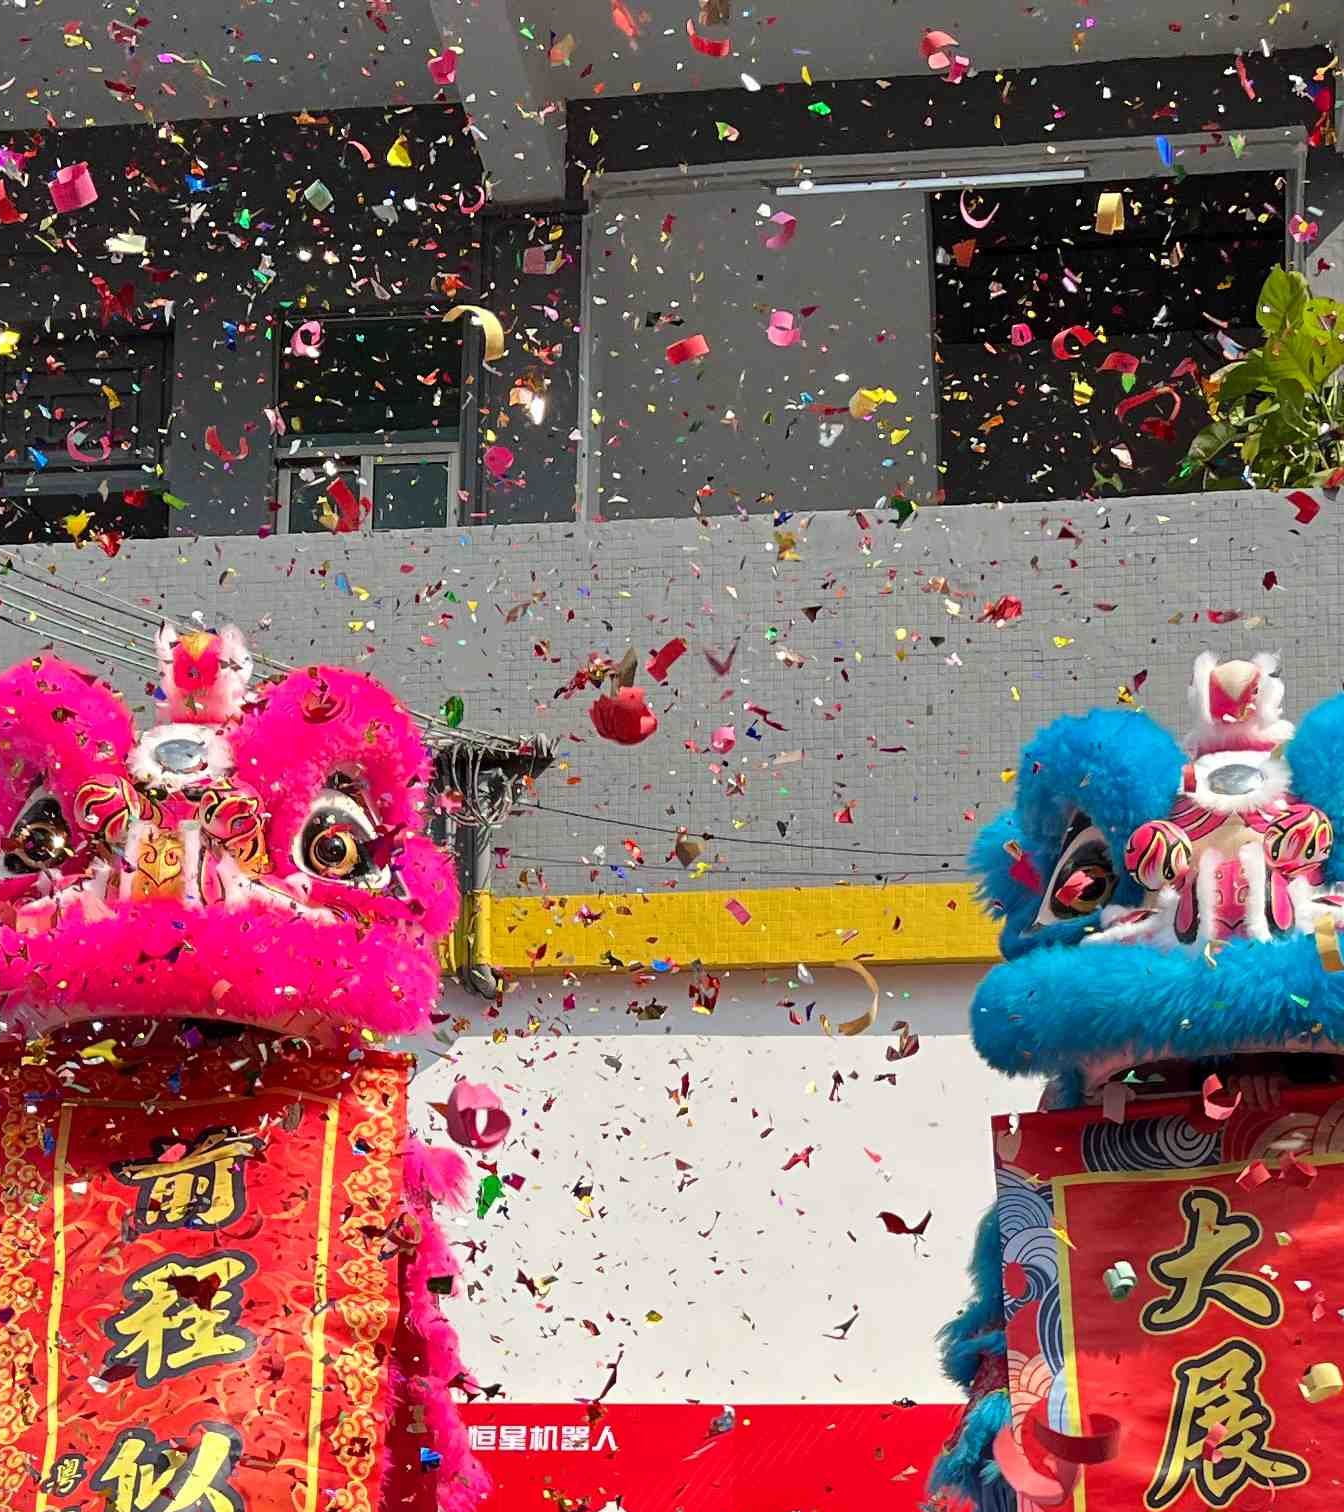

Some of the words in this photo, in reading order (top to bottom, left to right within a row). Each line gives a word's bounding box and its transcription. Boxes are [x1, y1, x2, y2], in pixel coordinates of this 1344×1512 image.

[467, 1425, 619, 1452] 恒星机器人
